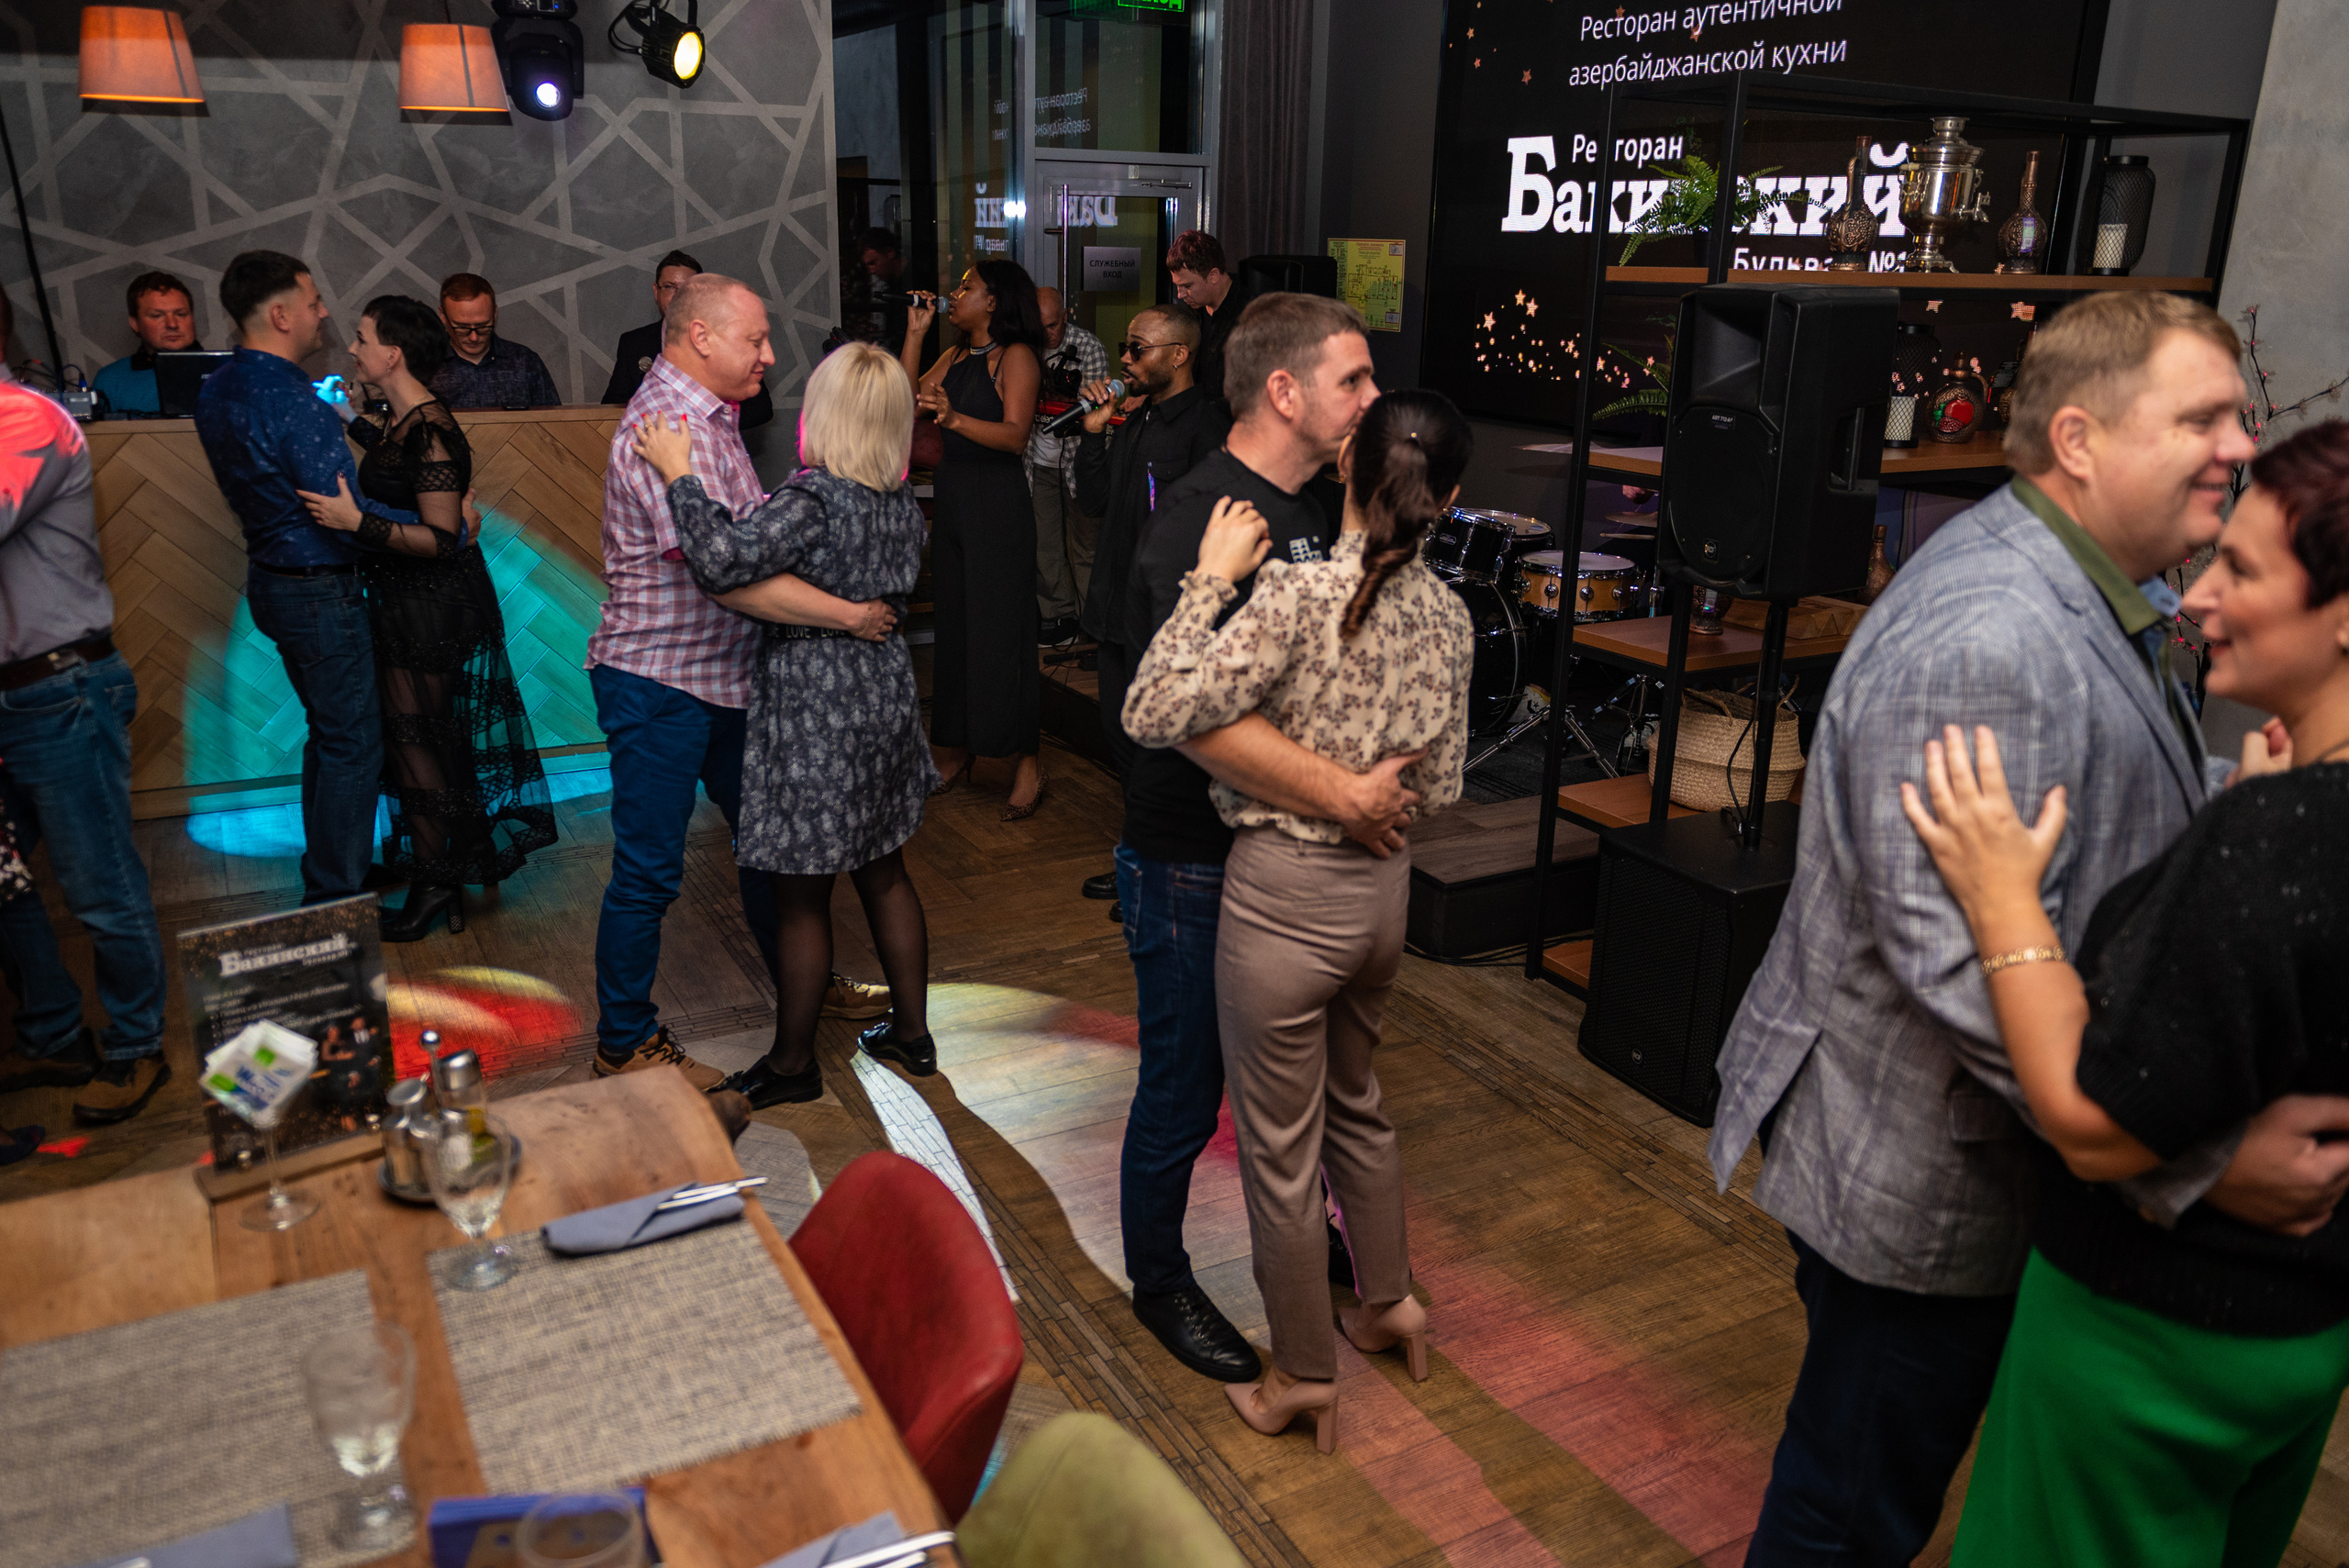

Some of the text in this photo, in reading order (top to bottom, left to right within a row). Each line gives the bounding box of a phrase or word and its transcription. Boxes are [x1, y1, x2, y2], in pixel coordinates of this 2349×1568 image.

[1580, 10, 1676, 42] Ресторан
[1568, 39, 1847, 91] азербайджанской кухни
[1572, 133, 1683, 169] Реторан
[1500, 135, 1909, 237] Бакикий
[1089, 259, 1136, 268] СЛУЖЕБНЫЙ
[1102, 270, 1122, 279] ВХОД
[1733, 247, 1834, 272] Бульв
